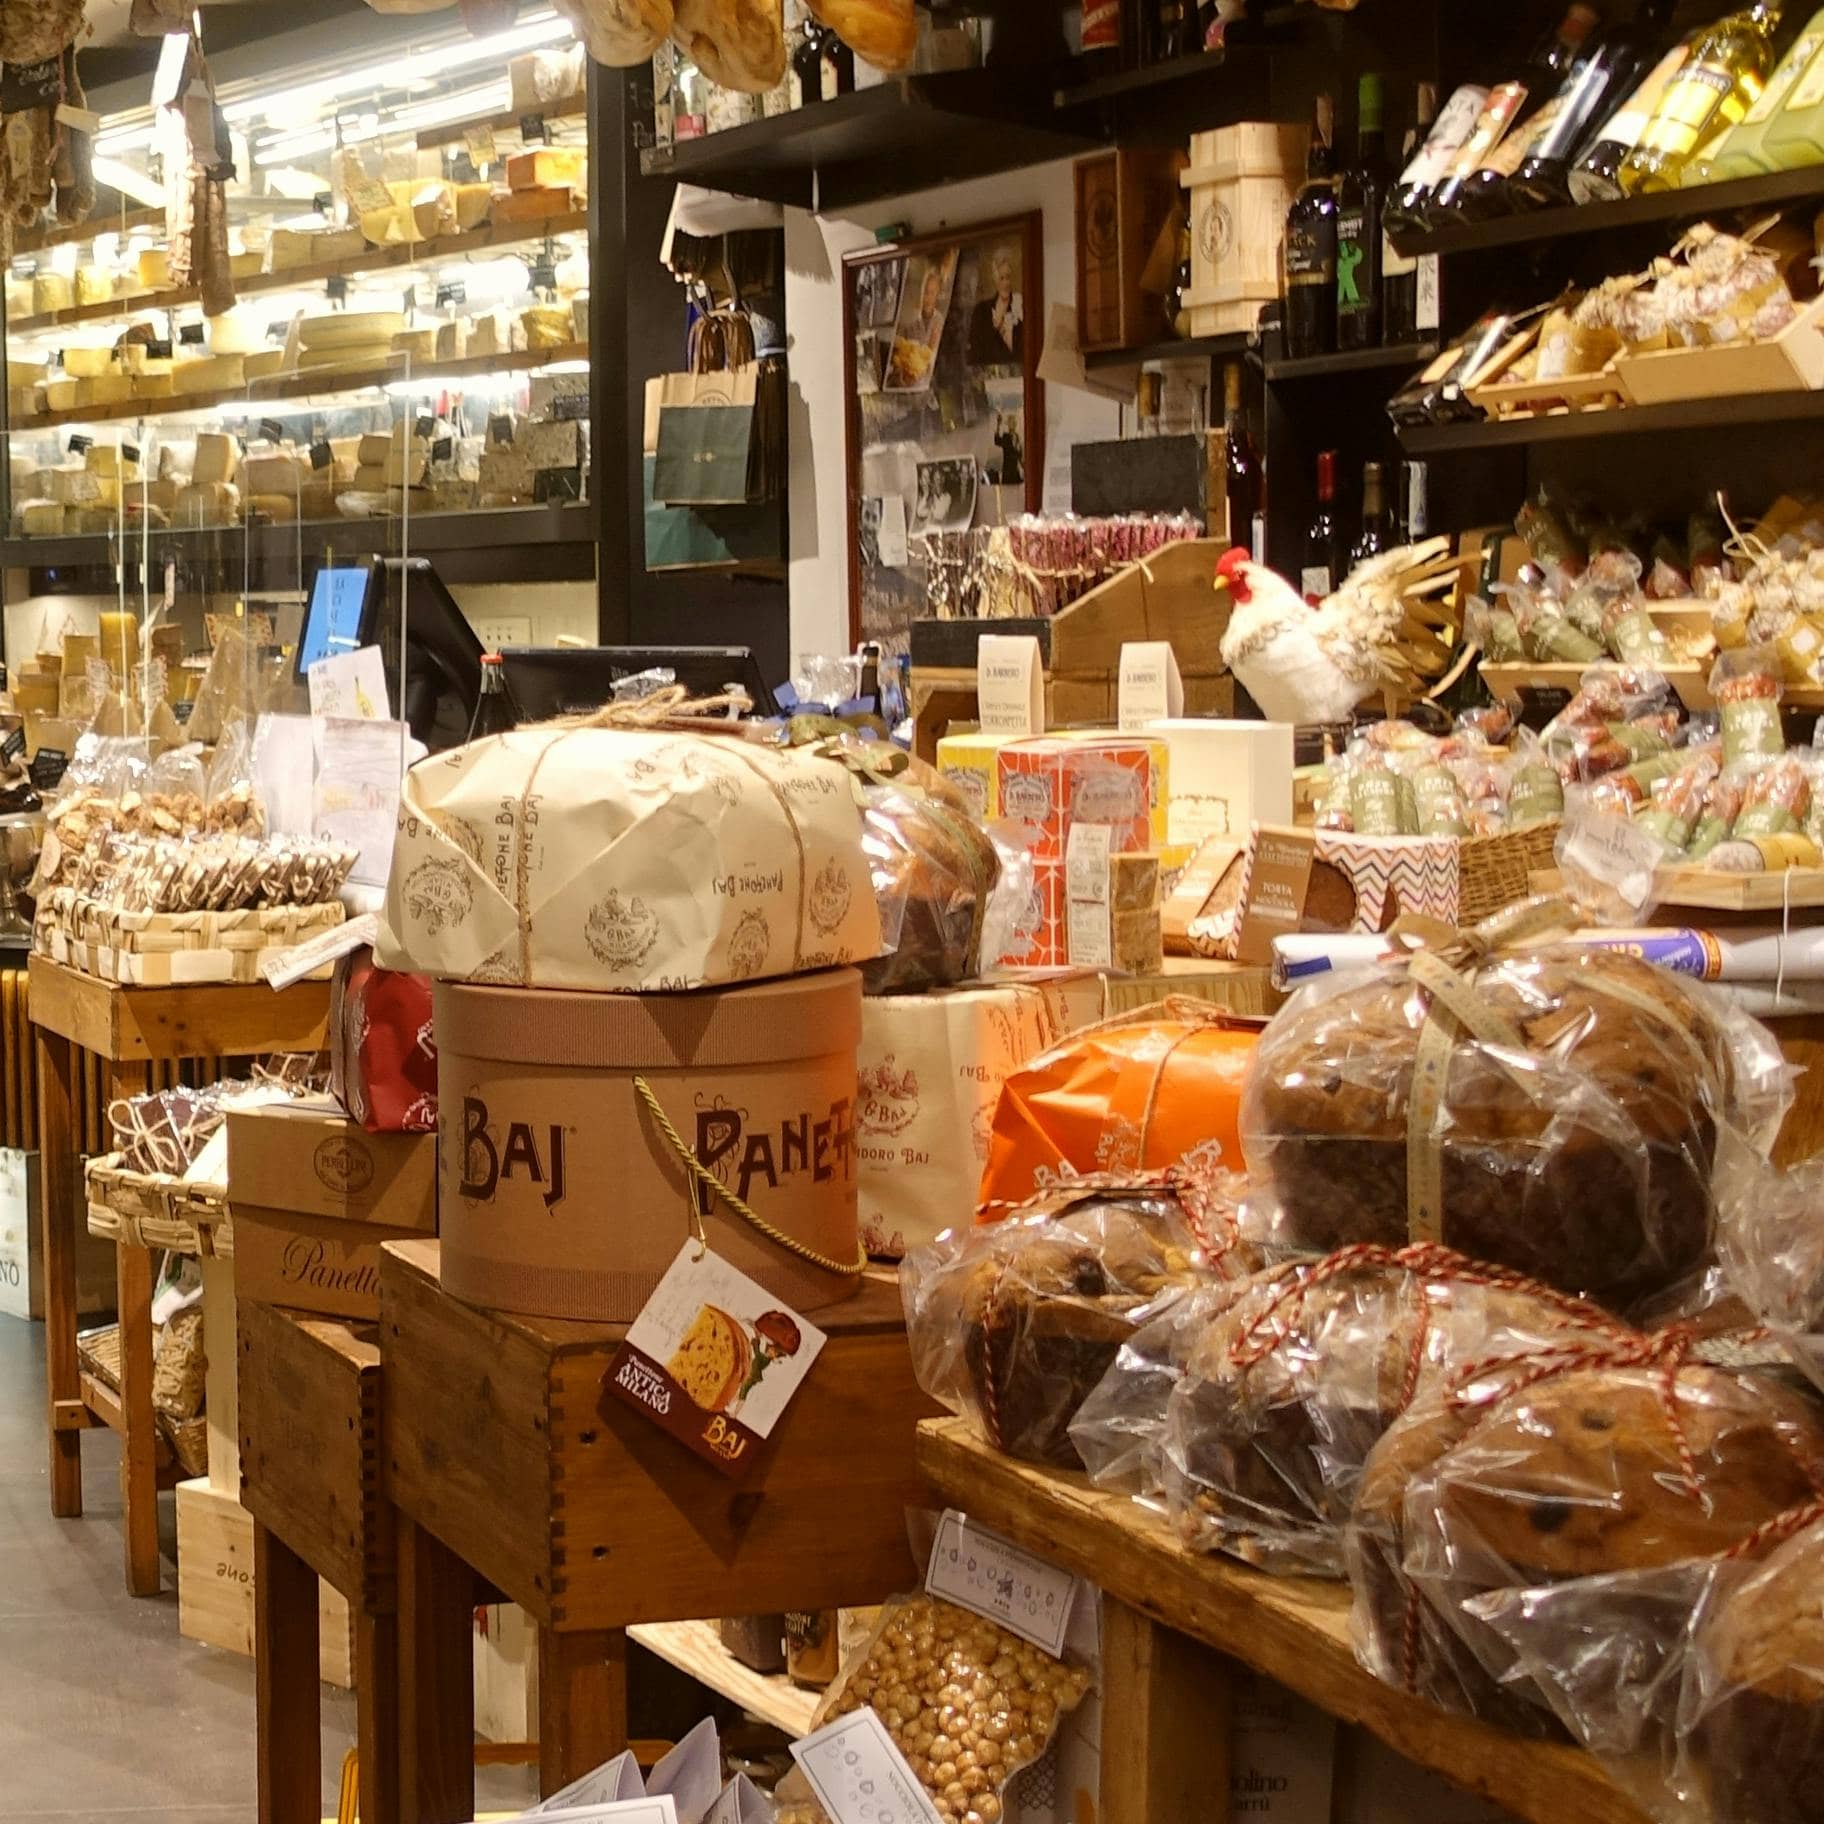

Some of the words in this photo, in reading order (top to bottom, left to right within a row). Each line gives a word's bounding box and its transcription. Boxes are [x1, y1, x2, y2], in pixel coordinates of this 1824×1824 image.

[458, 1085, 568, 1218] BAJ
[615, 1372, 670, 1415] MILANO
[620, 1361, 672, 1405] ANTICA
[701, 1414, 747, 1460] BAJ
